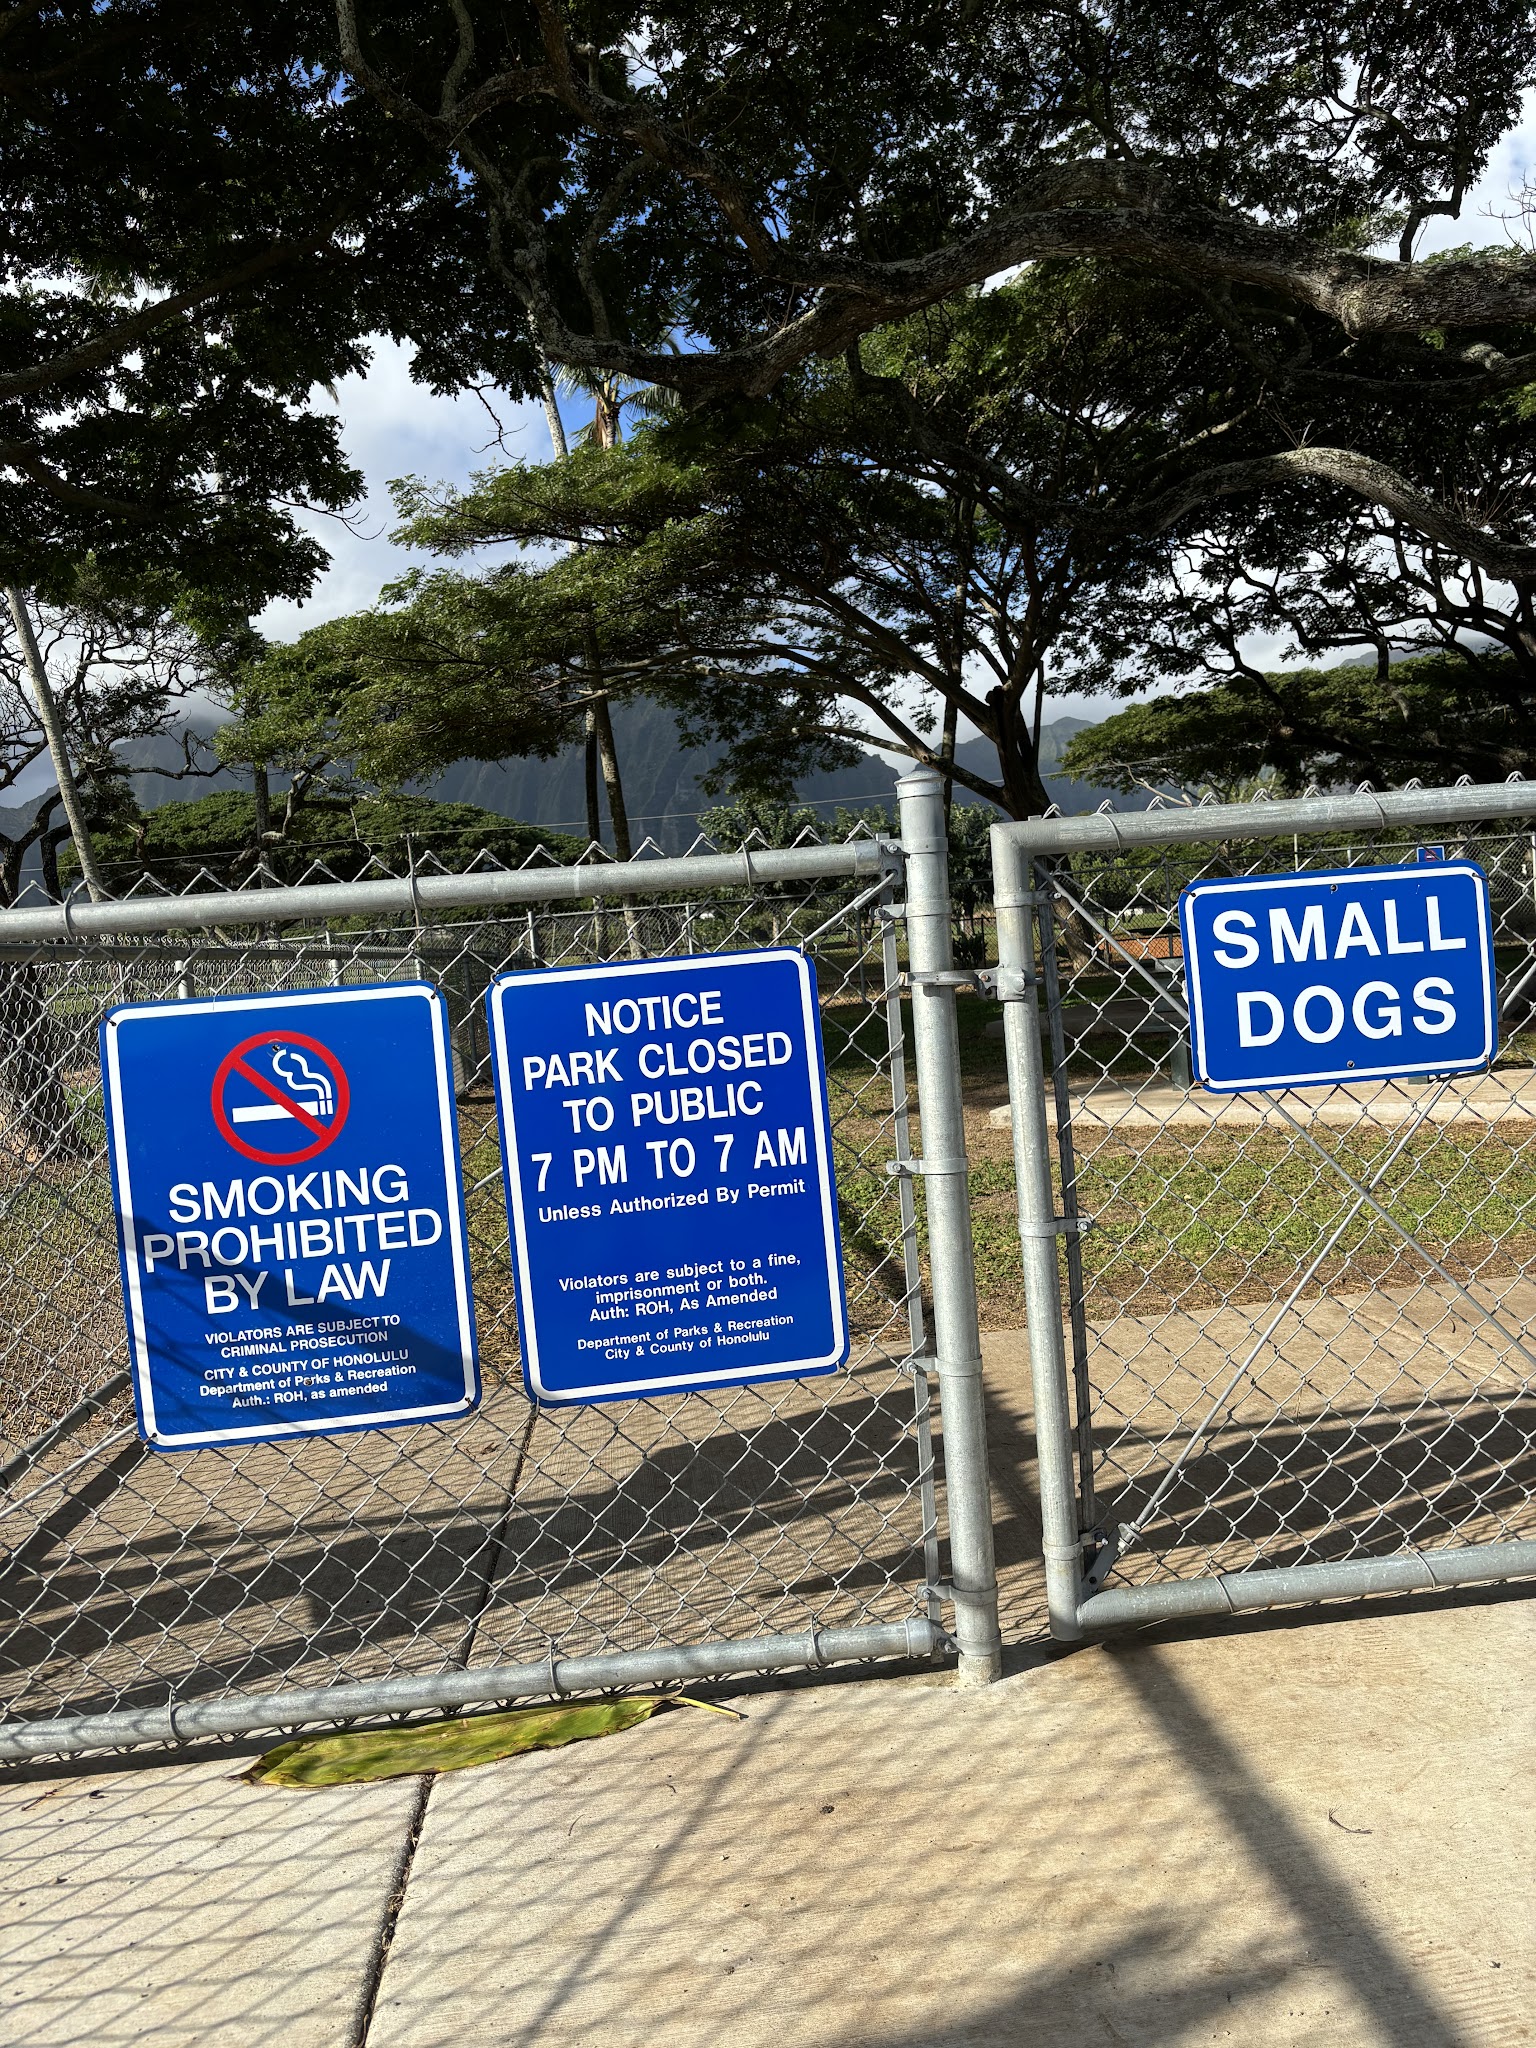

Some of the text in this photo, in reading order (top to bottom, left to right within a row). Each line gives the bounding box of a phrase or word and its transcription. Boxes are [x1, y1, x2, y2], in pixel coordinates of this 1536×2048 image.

[1213, 896, 1466, 968] SMALL
[585, 991, 724, 1036] NOTICE
[1237, 977, 1456, 1047] DOGS
[523, 1032, 792, 1090] PARK CLOSED
[563, 1081, 763, 1133] TO PUBLIC
[531, 1127, 807, 1192] 7 PM TO 7 AM
[169, 1164, 409, 1223] SMOKING
[539, 1179, 805, 1222] Unless Authorized By Permit
[143, 1208, 442, 1273] PROHIBITED
[205, 1259, 391, 1314] BY LAW
[559, 1253, 800, 1291] Violators are subject to a fine,
[596, 1273, 767, 1304] imprisonment or both.
[590, 1287, 777, 1321] Auth: ROH, As Amended
[205, 1315, 400, 1344] VIOLATORS ARE SUBJECT TO
[221, 1331, 387, 1358] CRIMINAL PROSECUTION
[578, 1315, 793, 1349] Department of Parks & Recreation
[605, 1331, 769, 1359] City & County of Honolulu
[200, 1379, 275, 1397] Department
[278, 1377, 291, 1388] of
[335, 1372, 344, 1382] &
[348, 1365, 416, 1380] Recreation
[204, 1349, 408, 1380] CITY & COUNTY OF HONOLULU
[233, 1381, 387, 1408] Auth.: ROH, as amended
